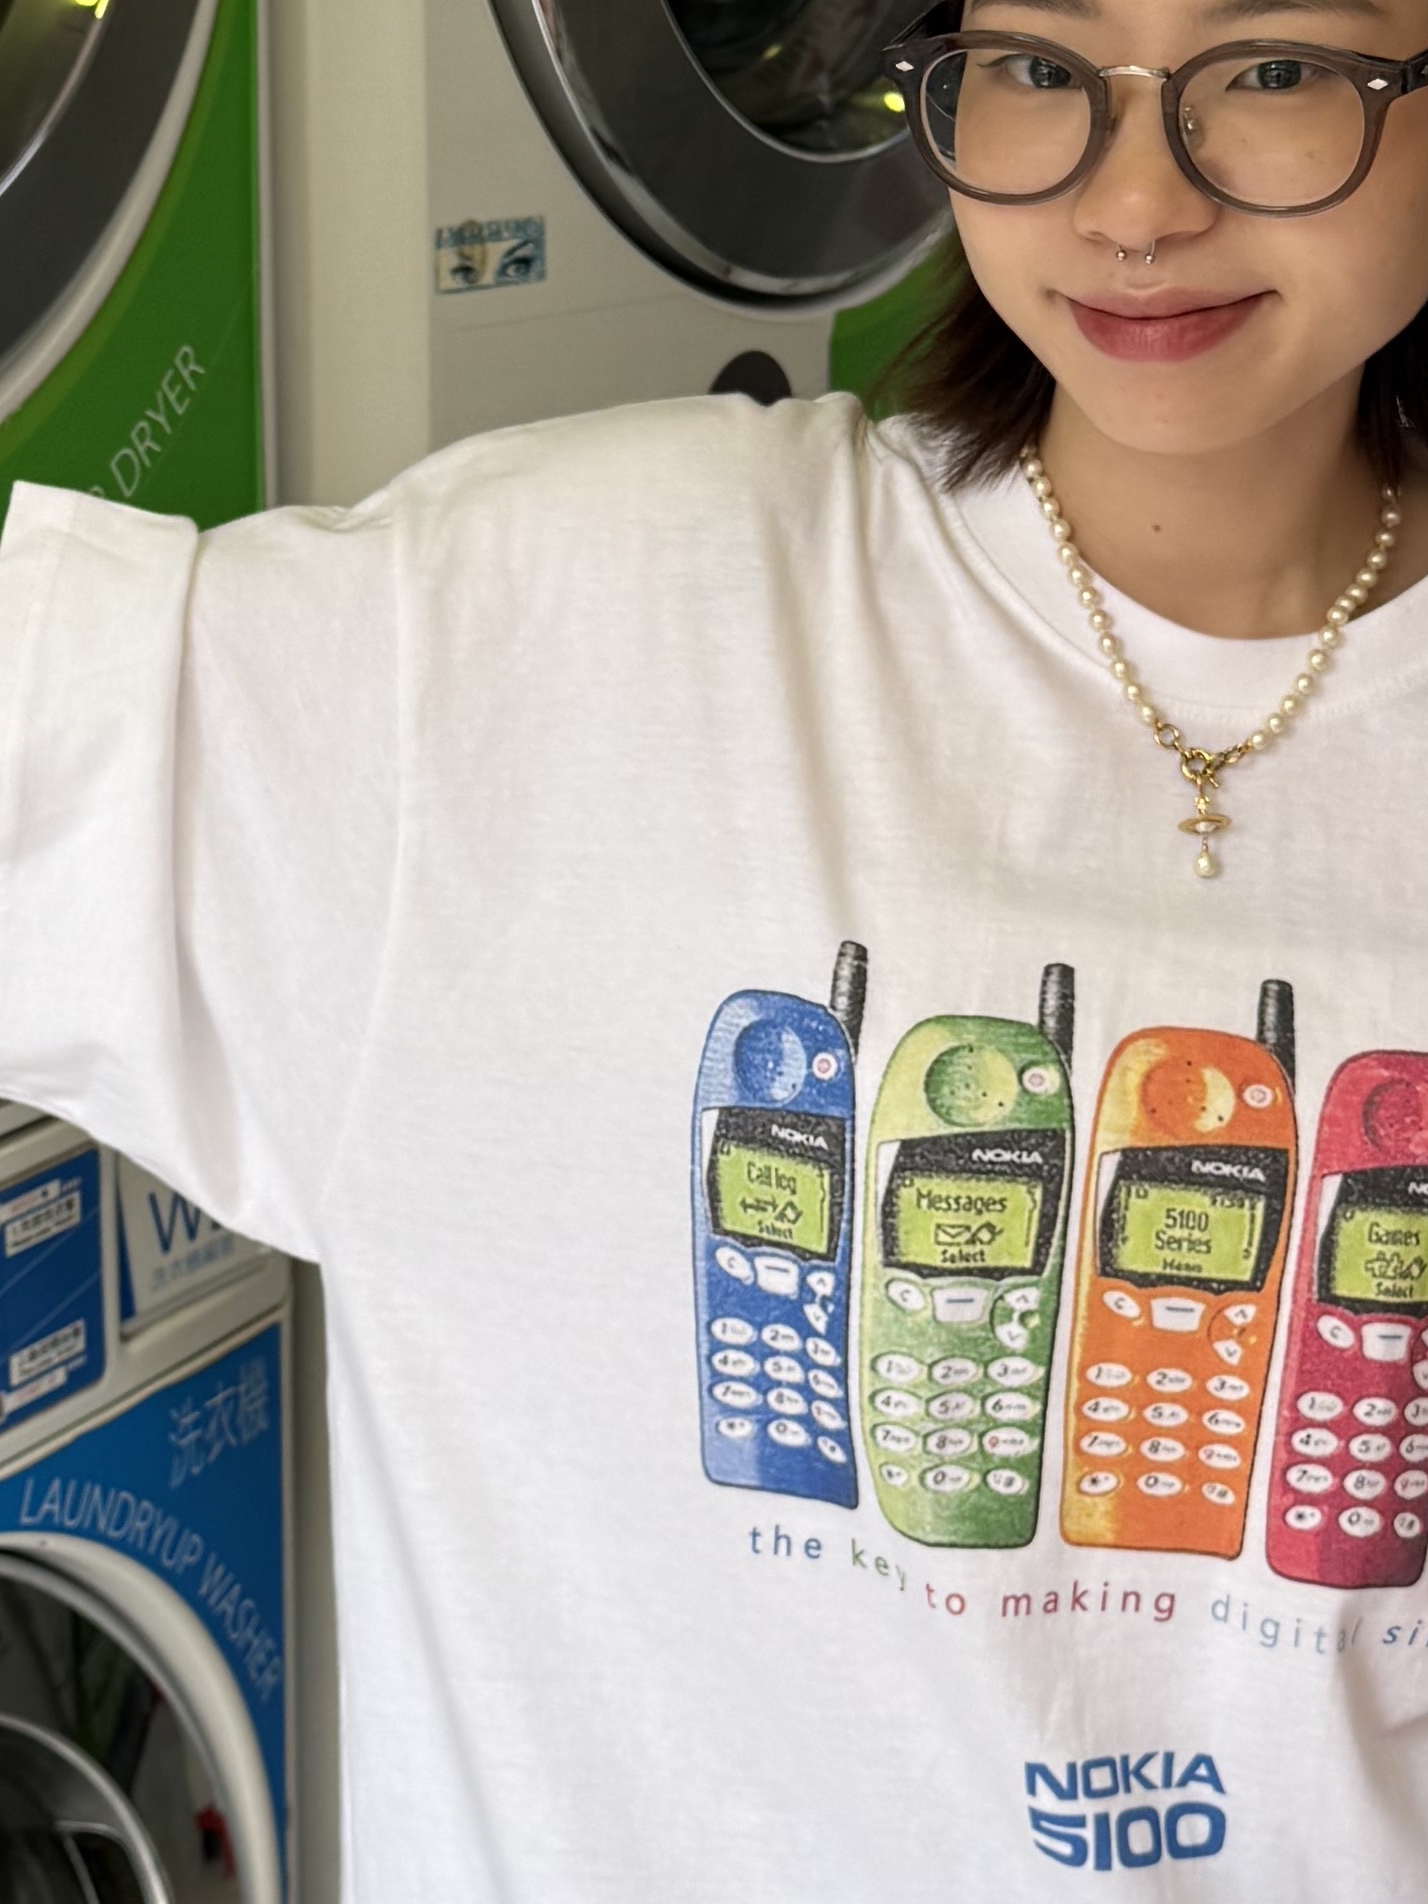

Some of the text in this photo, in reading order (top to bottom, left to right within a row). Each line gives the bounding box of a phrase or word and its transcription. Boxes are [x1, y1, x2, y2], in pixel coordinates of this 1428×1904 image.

[110, 345, 206, 498] DRYER
[771, 1124, 829, 1151] NOKIA
[973, 1147, 1043, 1164] NOKIA
[1192, 1160, 1266, 1183] NOKIA
[916, 1185, 1008, 1215] Messages
[147, 1191, 224, 1254] W
[1164, 1207, 1209, 1233] 5100
[1155, 1229, 1212, 1255] Series
[1367, 1222, 1420, 1248] Games
[940, 1247, 986, 1265] Select
[1374, 1280, 1414, 1299] Select
[169, 1354, 270, 1487] 洗衣機
[20, 1478, 281, 1702] LAUNDRYUP WASHER
[749, 1525, 823, 1560] the
[851, 1539, 906, 1592] key
[925, 1583, 966, 1615] to
[1001, 1581, 1177, 1622] making
[1211, 1594, 1361, 1654] digital
[1024, 1750, 1227, 1801] NOKIA
[1027, 1801, 1227, 1873] 5100
